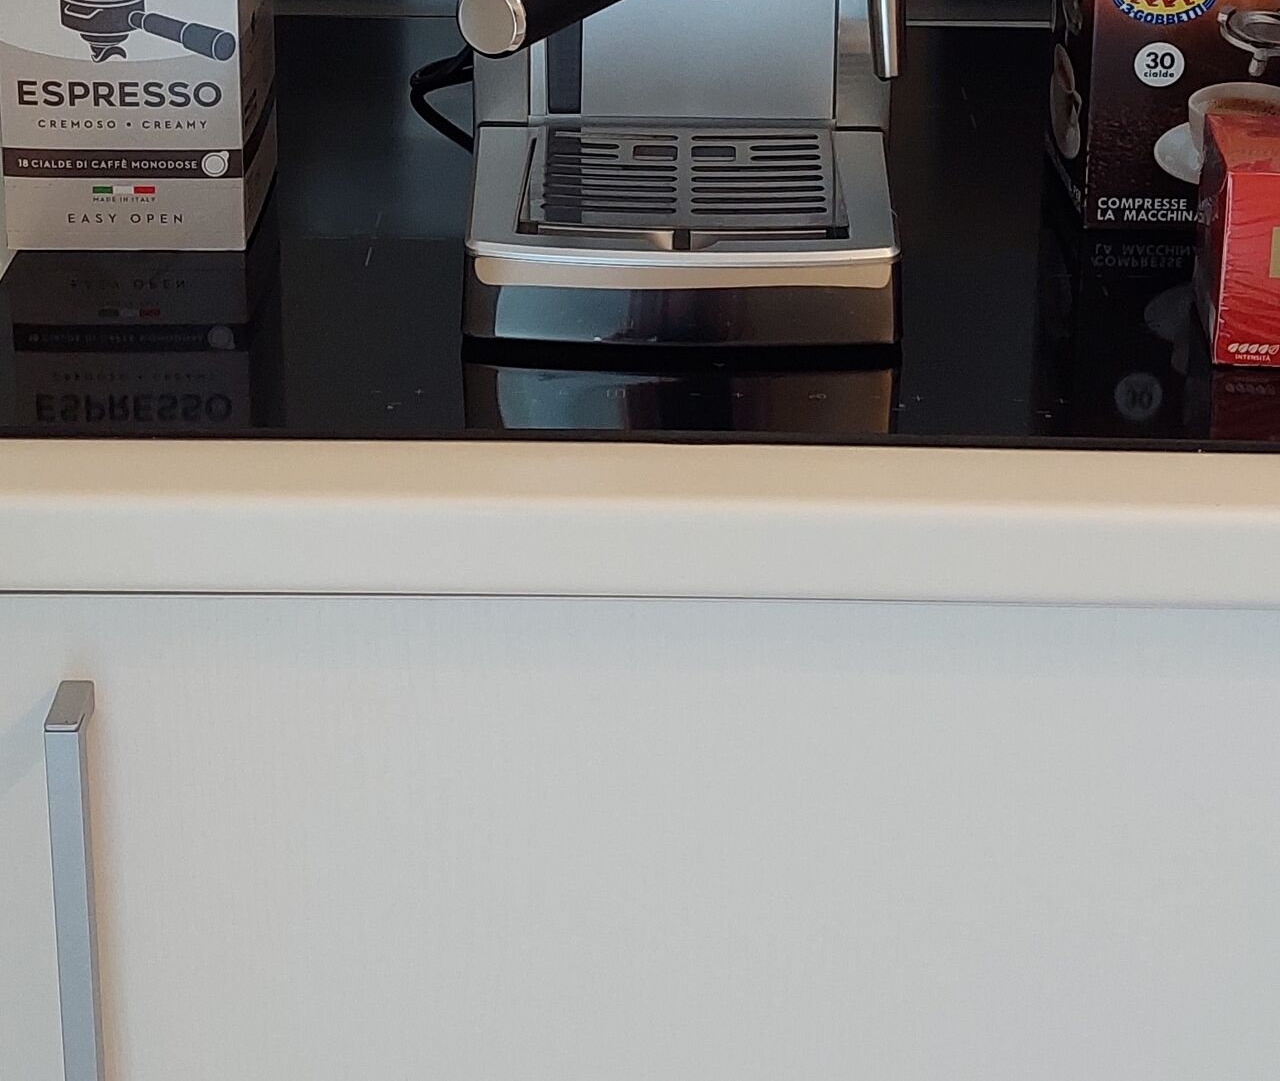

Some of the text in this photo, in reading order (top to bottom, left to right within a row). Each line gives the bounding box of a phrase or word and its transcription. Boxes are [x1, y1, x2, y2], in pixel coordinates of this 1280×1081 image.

[1145, 51, 1176, 70] 30
[1143, 69, 1175, 79] cialde
[17, 80, 222, 108] ESPRESSO
[38, 119, 209, 130] CREMOSO CREAMY
[18, 157, 198, 169] 18 CIALDE DI CAFFÈ MONODOSE
[1098, 197, 1187, 210] COMPRESSE
[67, 213, 185, 225] EASY OPEN
[1097, 209, 1115, 221] LA
